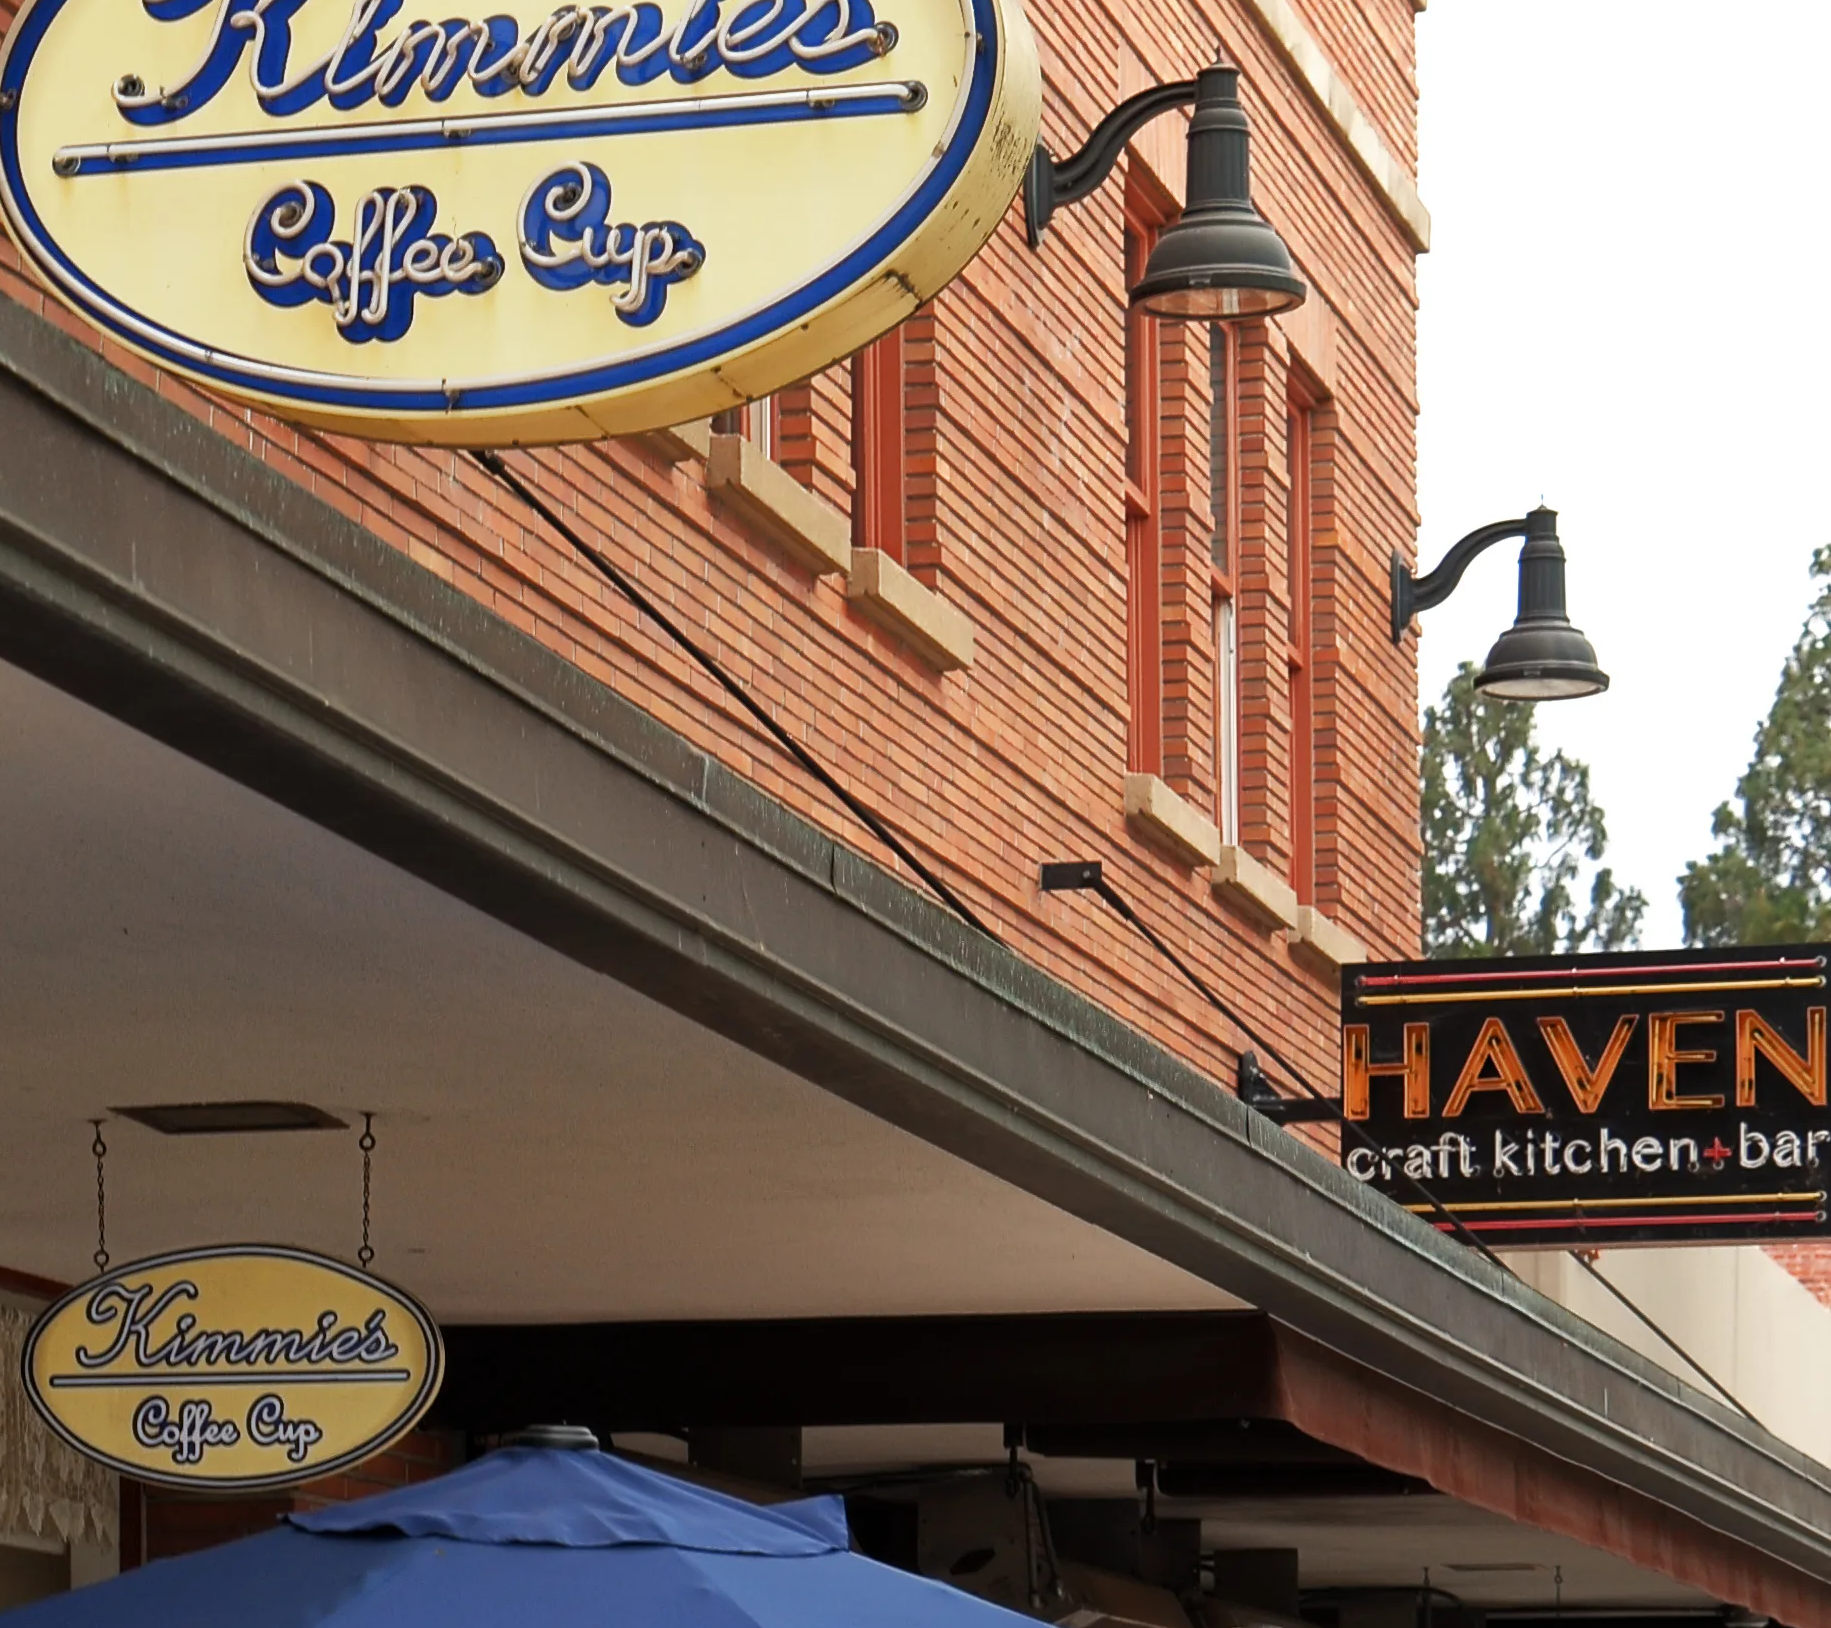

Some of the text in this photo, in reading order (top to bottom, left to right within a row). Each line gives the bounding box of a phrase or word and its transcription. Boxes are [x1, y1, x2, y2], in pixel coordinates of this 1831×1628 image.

[244, 159, 707, 345] Coffee Cup
[1343, 1005, 1829, 1122] HAVEN
[1345, 1130, 1477, 1182] craft
[1493, 1126, 1700, 1177] kitchen
[76, 1280, 399, 1370] Kimmie's
[132, 1392, 322, 1464] Coffee Cup
